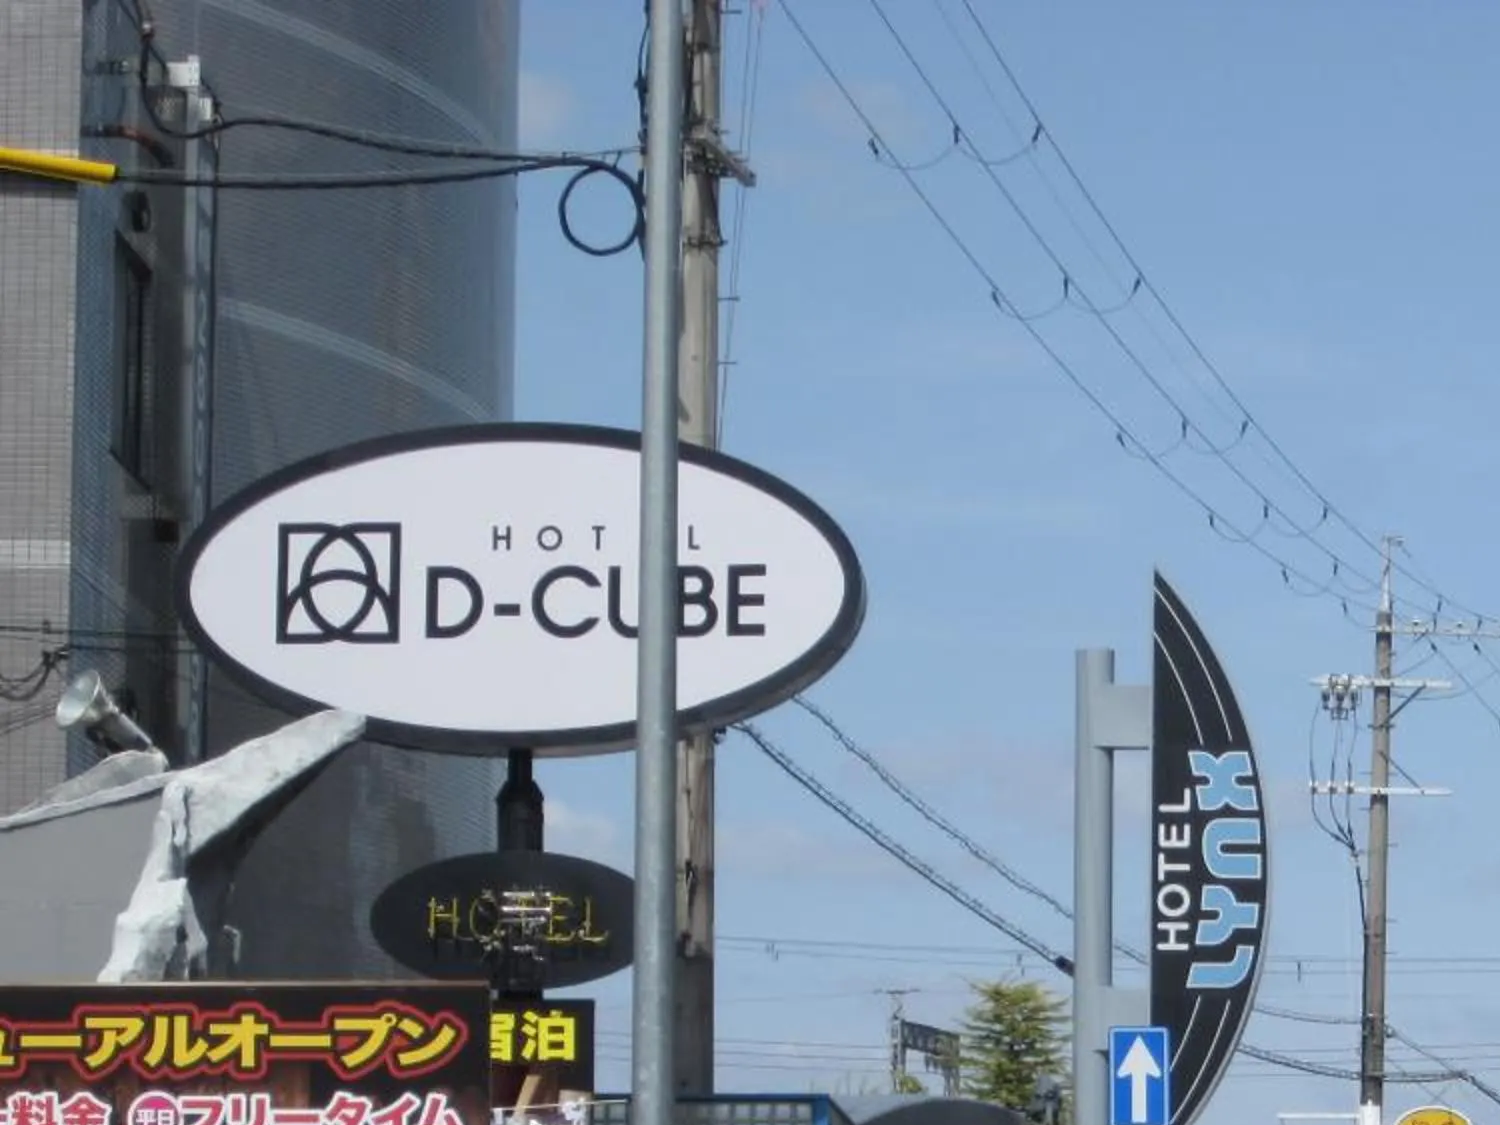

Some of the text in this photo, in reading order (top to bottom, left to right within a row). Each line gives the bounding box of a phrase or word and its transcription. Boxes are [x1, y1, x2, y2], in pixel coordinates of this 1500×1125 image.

[491, 524, 701, 551] HOTL
[425, 564, 767, 639] D-CUBE
[1157, 788, 1192, 952] HOTEL
